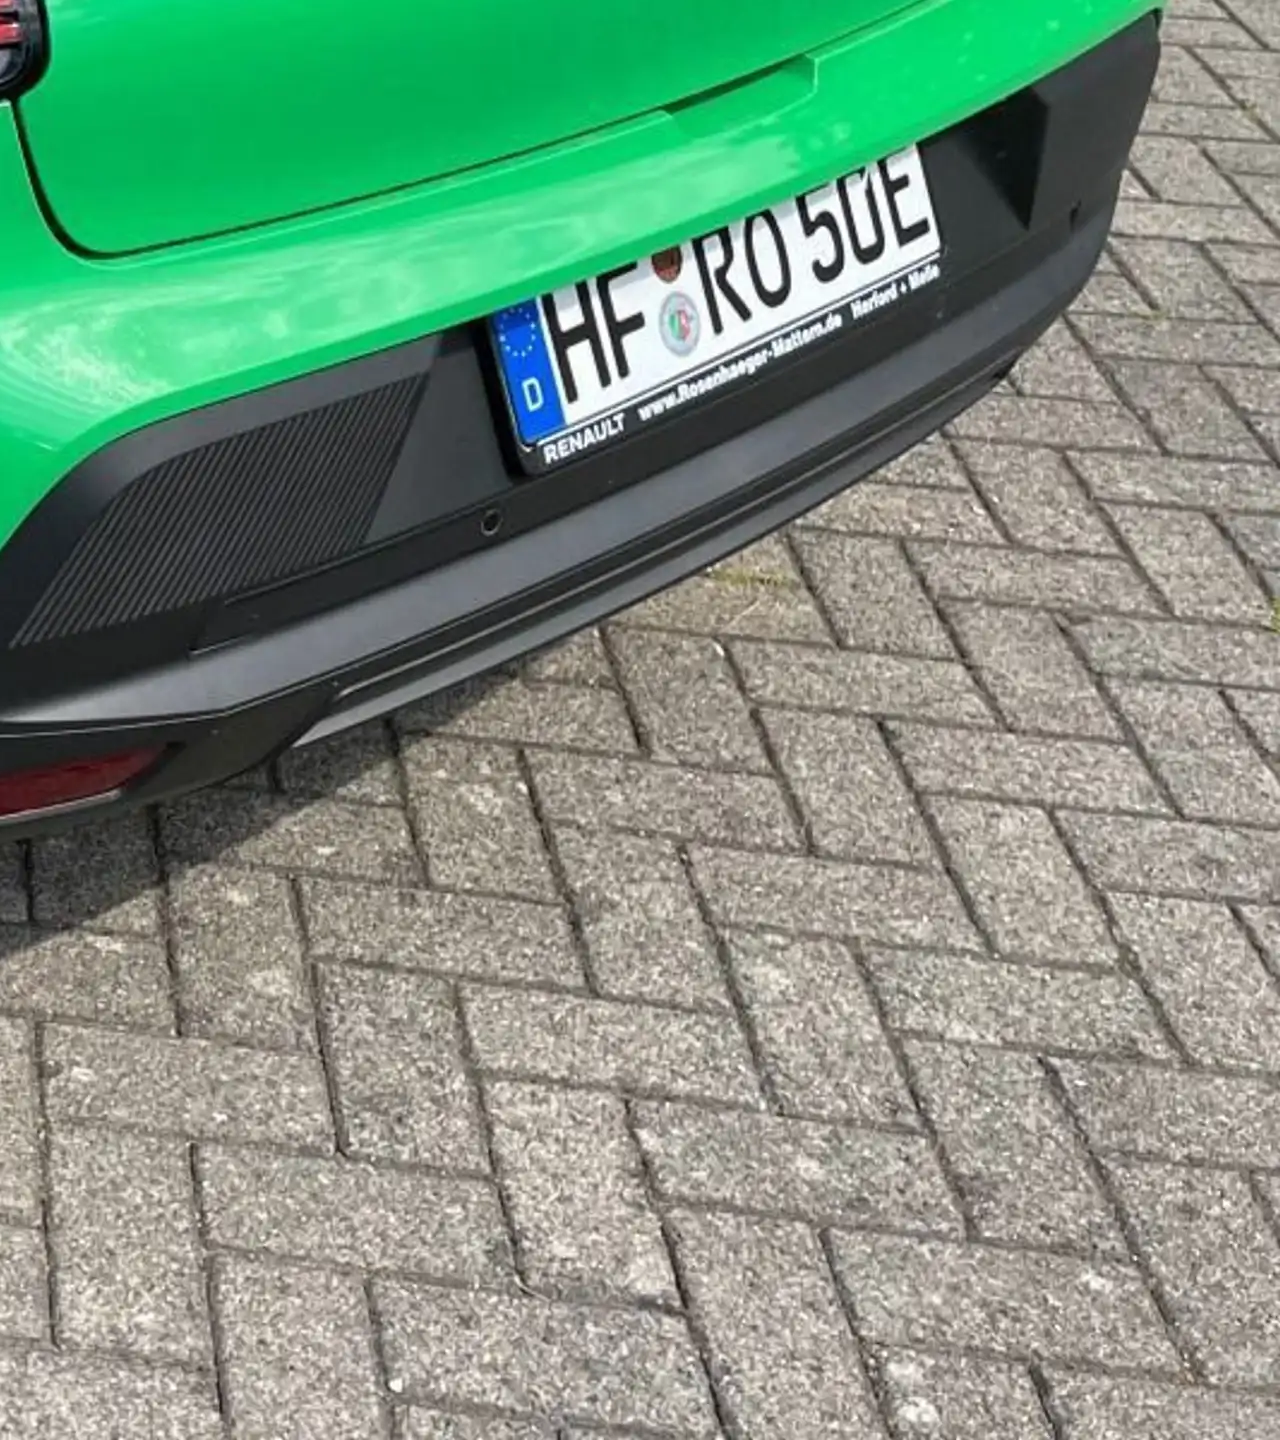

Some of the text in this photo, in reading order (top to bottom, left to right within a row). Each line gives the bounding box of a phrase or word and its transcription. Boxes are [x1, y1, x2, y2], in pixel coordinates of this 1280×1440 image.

[542, 158, 931, 404] HF RO 50E
[543, 412, 625, 464] RENAULT
[638, 312, 843, 422] www.Rosenhaeger-Mattern.de
[850, 281, 898, 319] Herford
[522, 376, 544, 412] D
